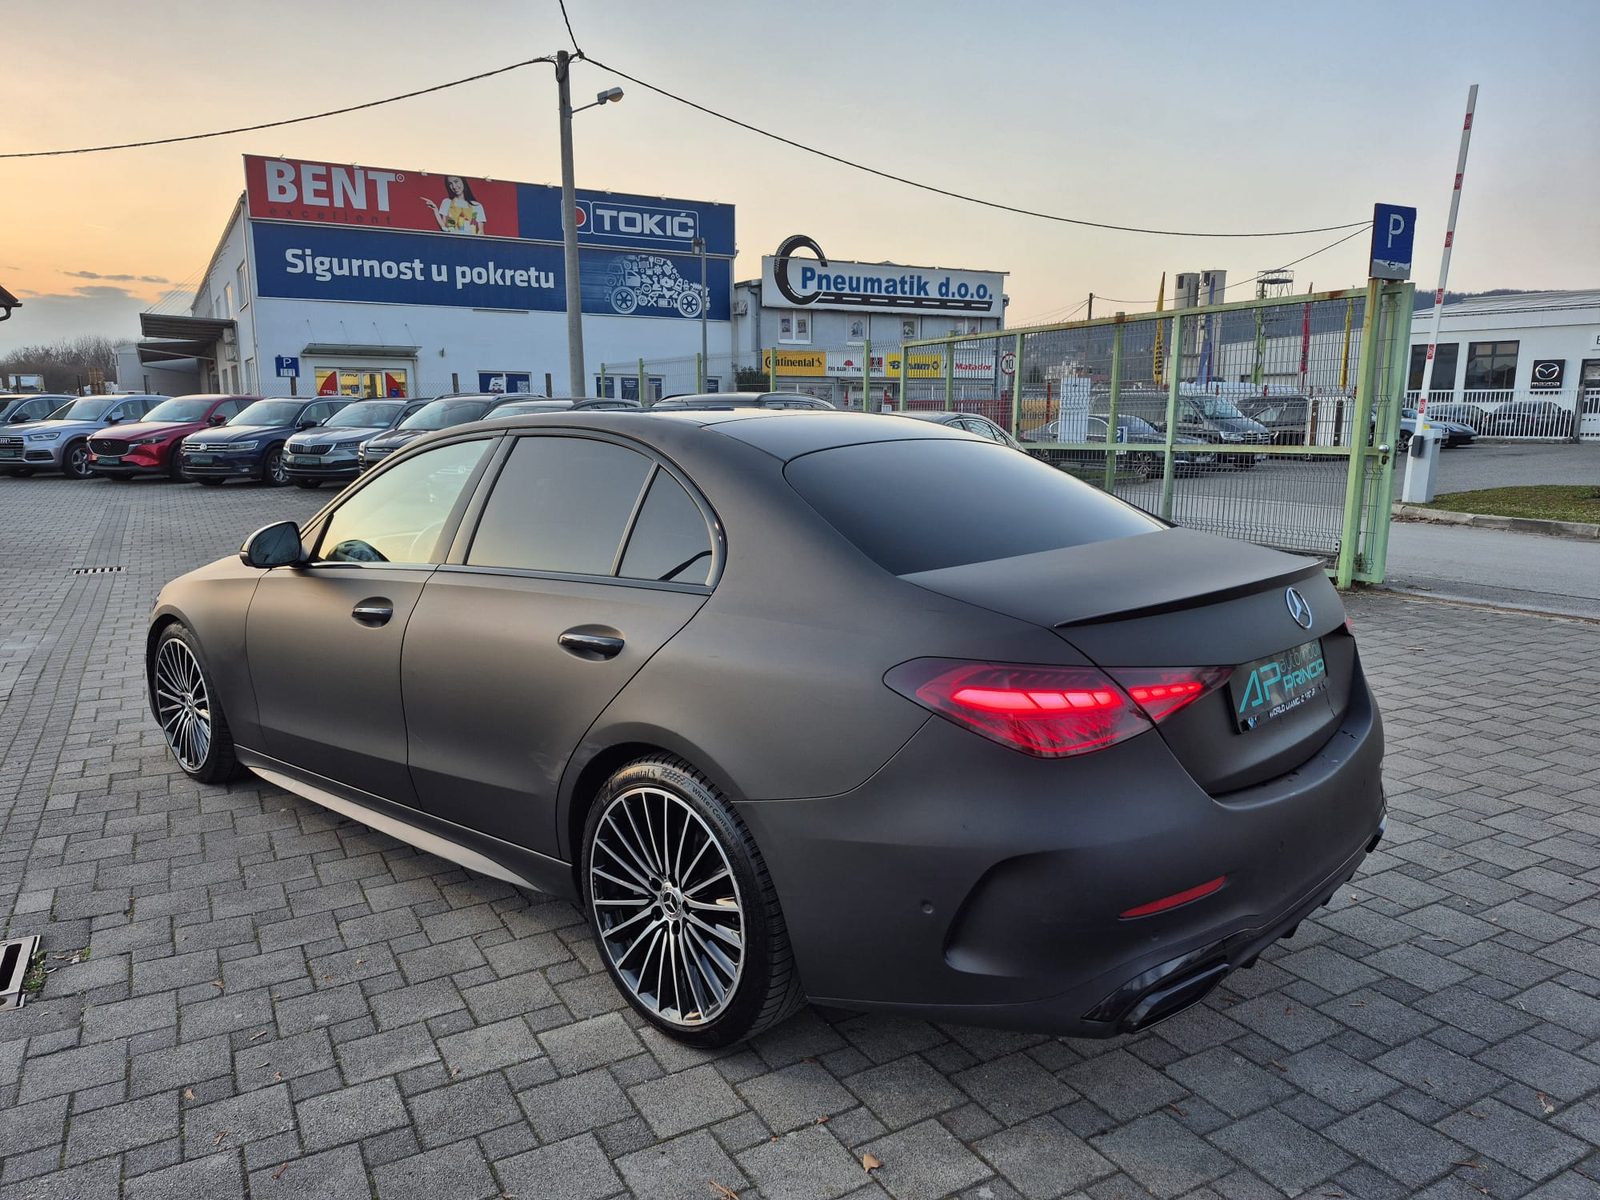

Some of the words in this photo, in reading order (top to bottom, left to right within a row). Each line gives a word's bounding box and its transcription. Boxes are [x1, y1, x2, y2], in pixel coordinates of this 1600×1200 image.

[265, 160, 397, 212] BENT
[595, 208, 695, 238] TOKIĆ
[1387, 213, 1405, 249] P
[285, 248, 425, 281] Sigurnost
[431, 264, 448, 282] u
[455, 261, 555, 290] pokretu
[801, 266, 930, 297] Pneumatik
[938, 276, 993, 300] d.o.o.
[283, 357, 292, 367] P
[765, 356, 814, 368] Cntinental
[954, 361, 992, 371] Matador
[1005, 358, 1014, 370] 10
